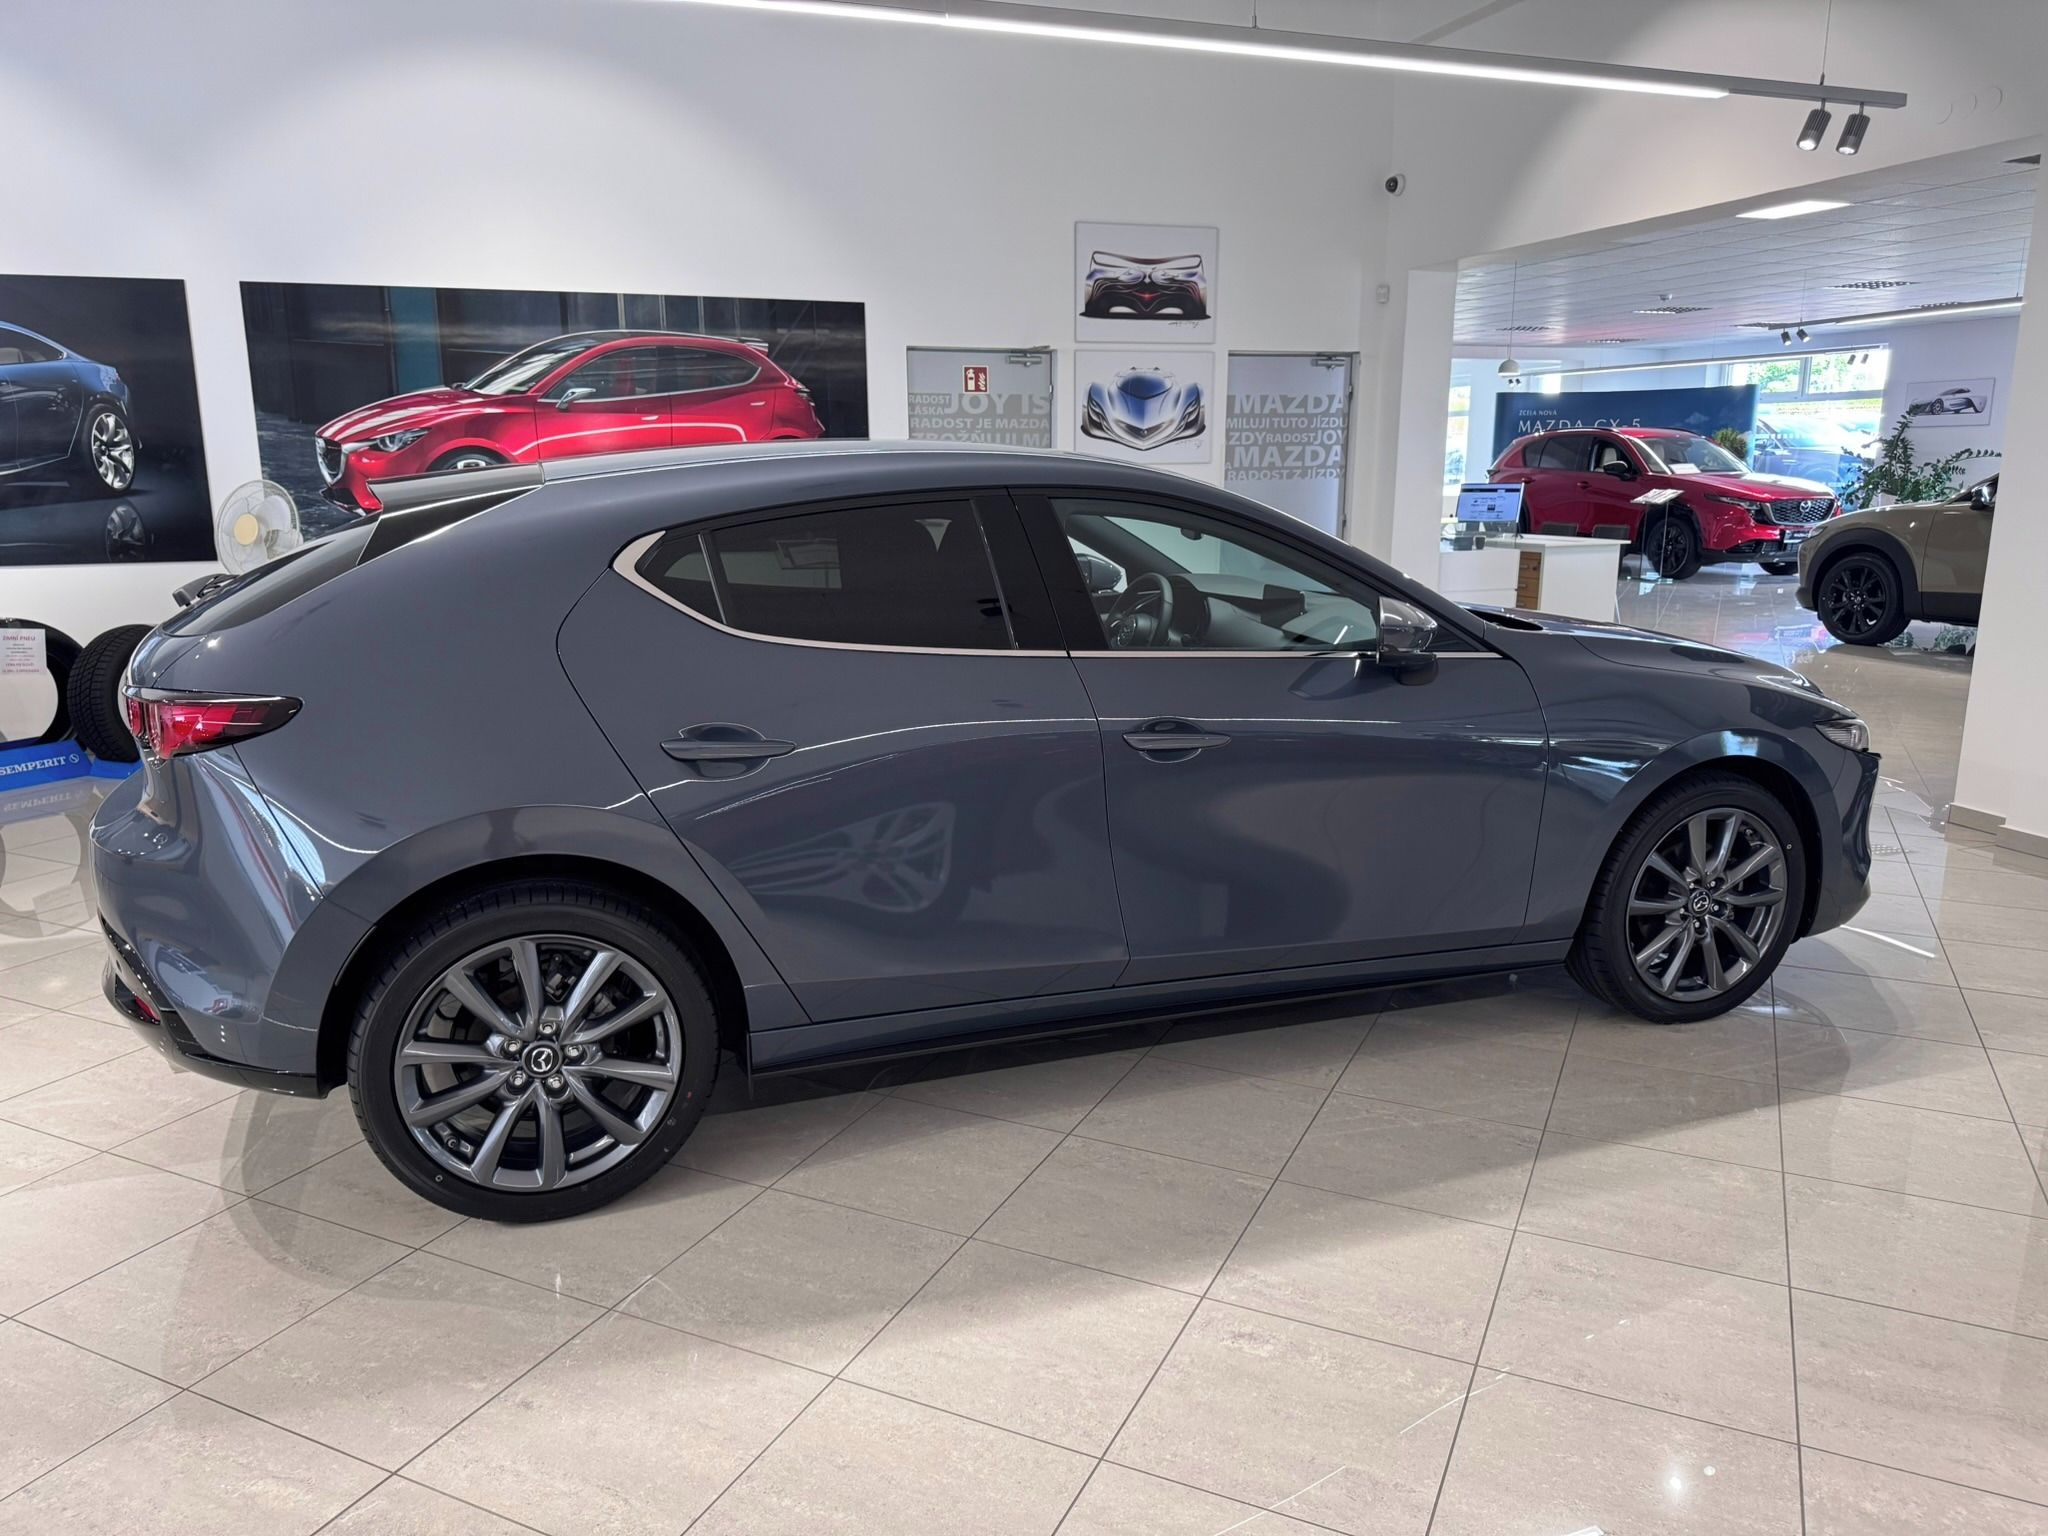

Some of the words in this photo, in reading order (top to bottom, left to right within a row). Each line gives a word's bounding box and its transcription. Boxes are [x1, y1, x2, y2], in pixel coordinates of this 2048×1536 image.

[908, 394, 951, 404] RADOST
[944, 393, 1009, 415] JOY
[1021, 394, 1050, 415] IS
[1234, 394, 1347, 414] MAZDA
[910, 418, 973, 429] RADOST
[975, 418, 992, 429] JE
[995, 418, 1050, 429] MAZDA
[1226, 417, 1269, 429] MILUJI
[1272, 417, 1308, 429] TUTO
[1310, 415, 1347, 429] JÍZDU
[1518, 419, 1583, 433] MAZDA
[1594, 418, 1640, 428] CX-5
[1266, 432, 1315, 443] RADOST
[1313, 429, 1346, 445] JOY
[1233, 445, 1346, 467] MAZDA
[1227, 469, 1289, 481] RADOST
[1292, 469, 1302, 480] Z
[1304, 467, 1345, 480] JÍZDY
[0, 756, 66, 776] SEMPERIT
